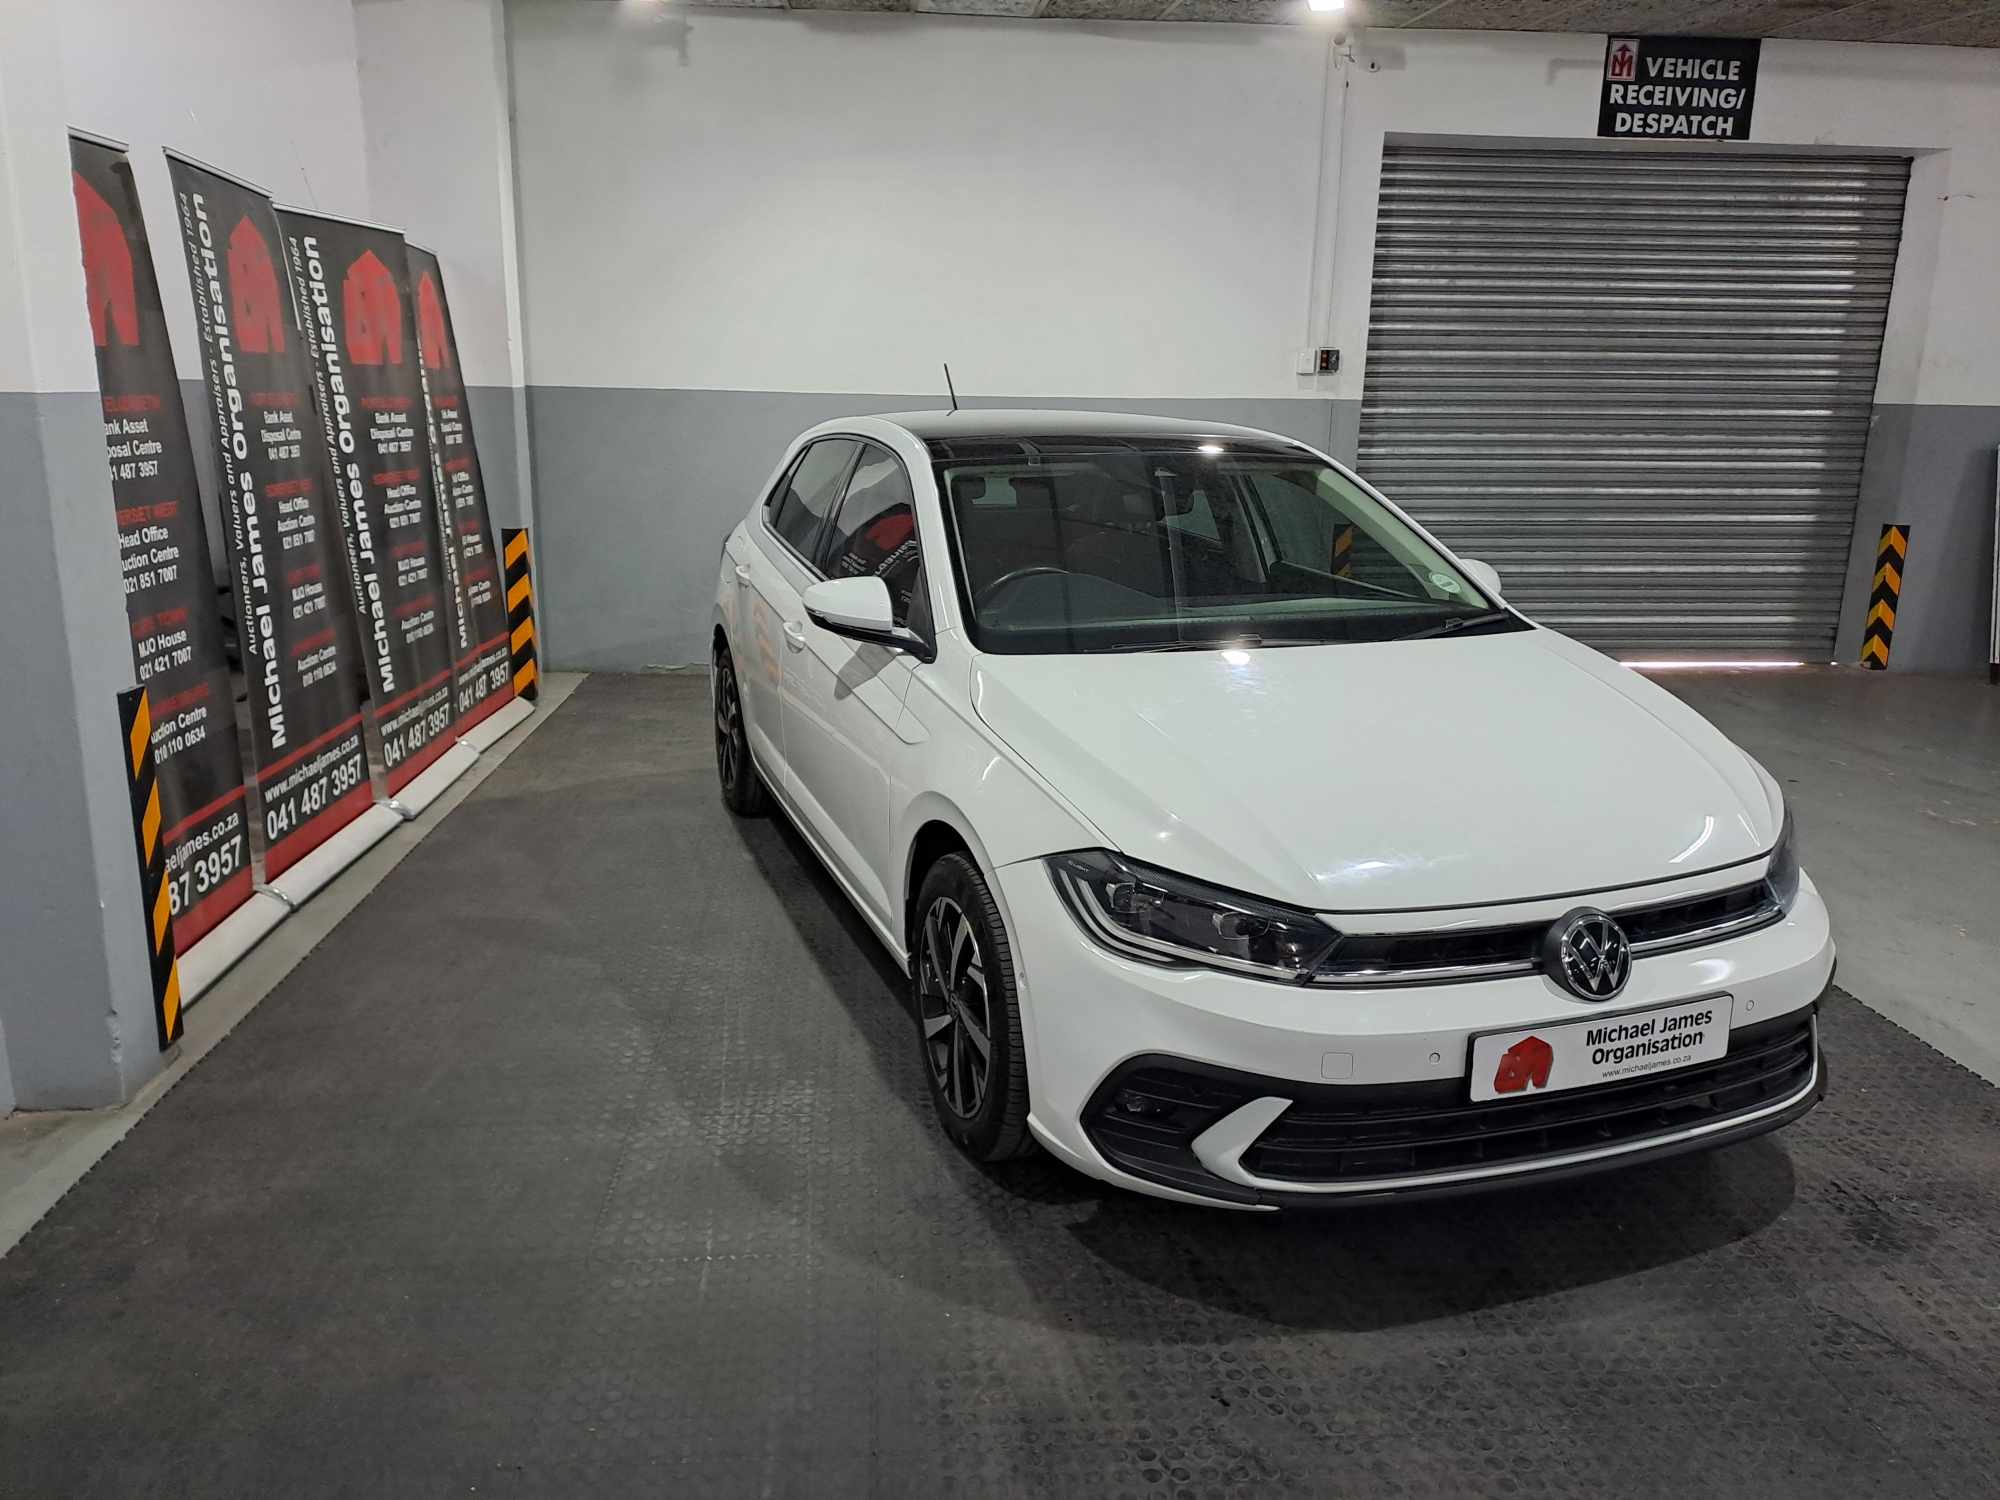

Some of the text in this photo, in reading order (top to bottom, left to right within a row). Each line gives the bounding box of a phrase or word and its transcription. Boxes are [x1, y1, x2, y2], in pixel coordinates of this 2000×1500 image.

[1646, 56, 1742, 81] VEHICLE
[1609, 83, 1747, 110] RECEIVING/
[1614, 112, 1735, 137] DESPATCH
[188, 240, 214, 343] Established
[296, 276, 320, 358] Established
[209, 359, 231, 449] Appraisers
[315, 370, 337, 445] Appraisers
[104, 418, 149, 435] ank Asset
[132, 439, 163, 456] Centre
[303, 236, 396, 693] Michael James Organisation
[328, 447, 341, 475] and
[120, 462, 136, 480] 487
[192, 193, 287, 749] Michael James Organisation
[222, 452, 236, 486] and
[229, 489, 245, 551] Valuers
[335, 478, 351, 528] Valuers
[119, 525, 169, 549] Head Office
[121, 545, 180, 571] uction Centre
[239, 556, 258, 655] Auctioneers,
[157, 630, 188, 650] House
[154, 654, 171, 673] 421
[459, 660, 510, 713] 041 487 3957
[151, 706, 207, 745] uction Centre
[384, 703, 450, 767] 041 487 3957
[267, 752, 362, 840] 041 487 3957
[168, 834, 242, 916] 87 3957
[1586, 1010, 1713, 1047] Michael James
[1592, 1031, 1704, 1065] Organisation
[1602, 1055, 1692, 1079] www.michaeljames.co.za
